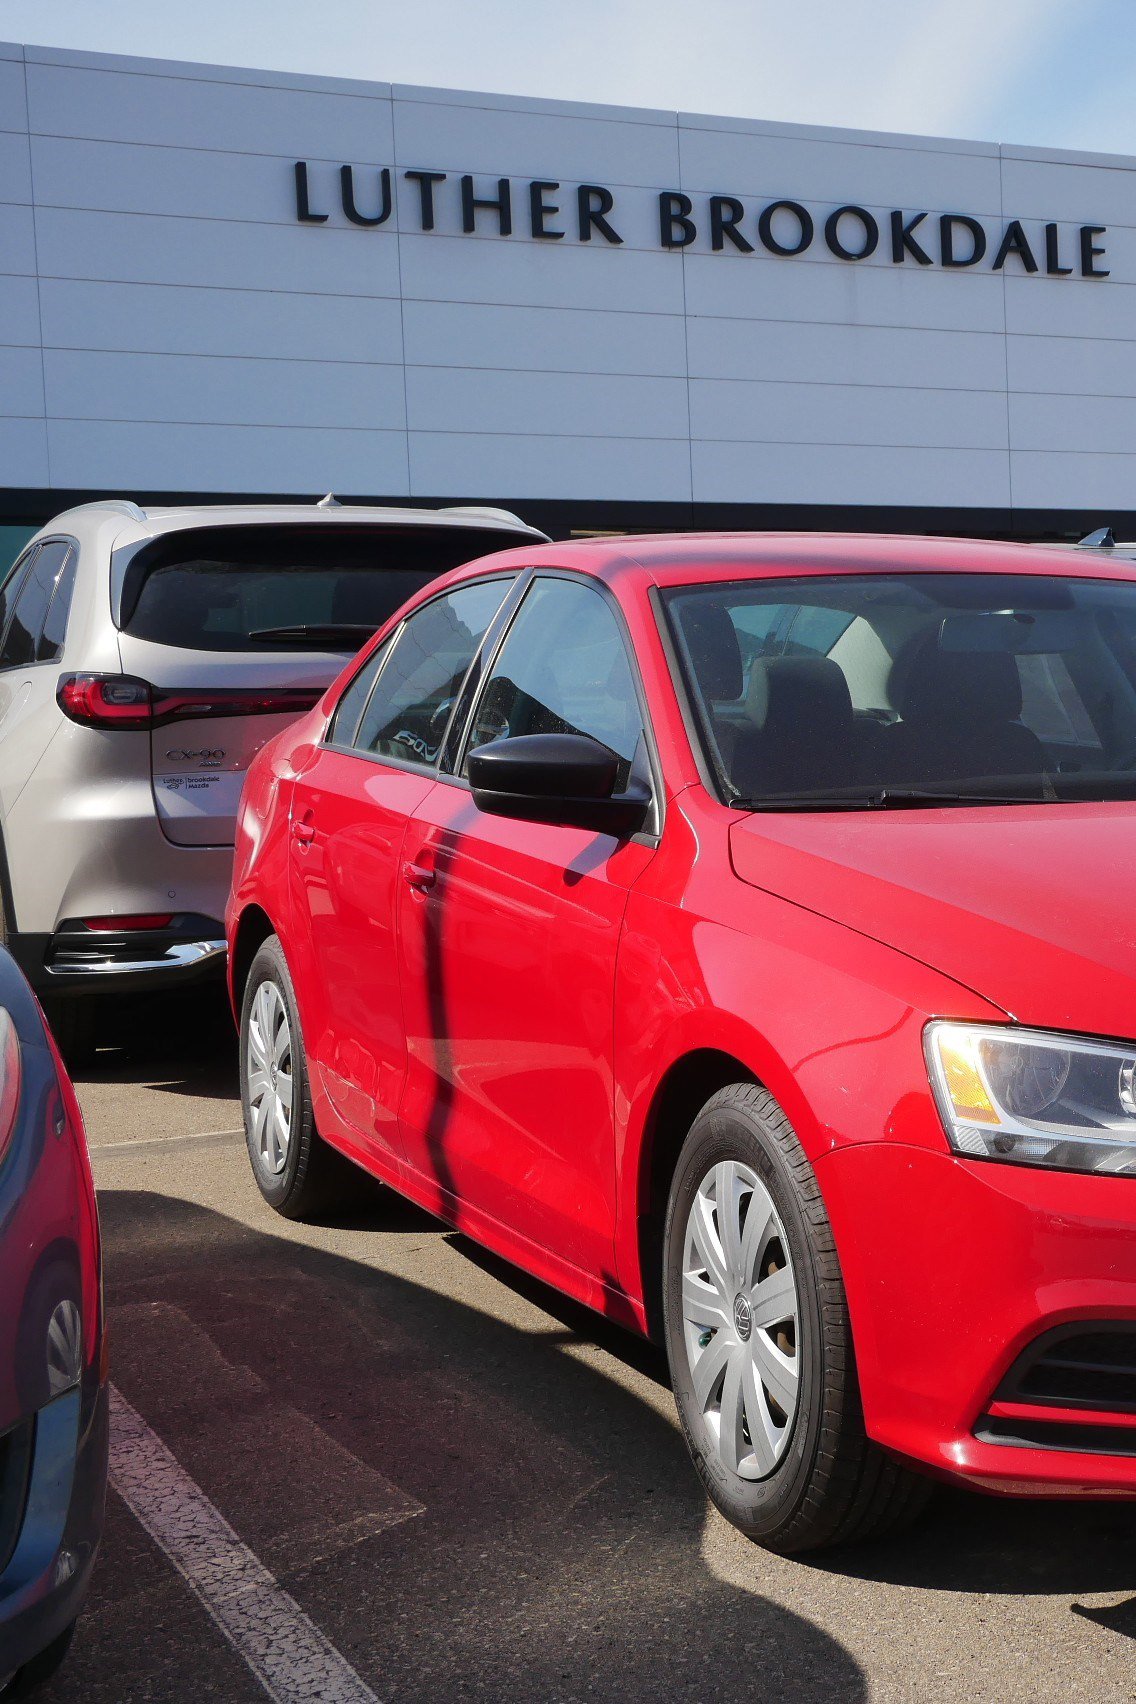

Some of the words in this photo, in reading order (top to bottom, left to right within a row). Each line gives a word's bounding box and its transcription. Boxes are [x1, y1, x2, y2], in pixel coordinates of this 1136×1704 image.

[295, 160, 624, 245] LUTHER
[658, 190, 1112, 278] BROOKDALE
[166, 748, 226, 761] CX-90
